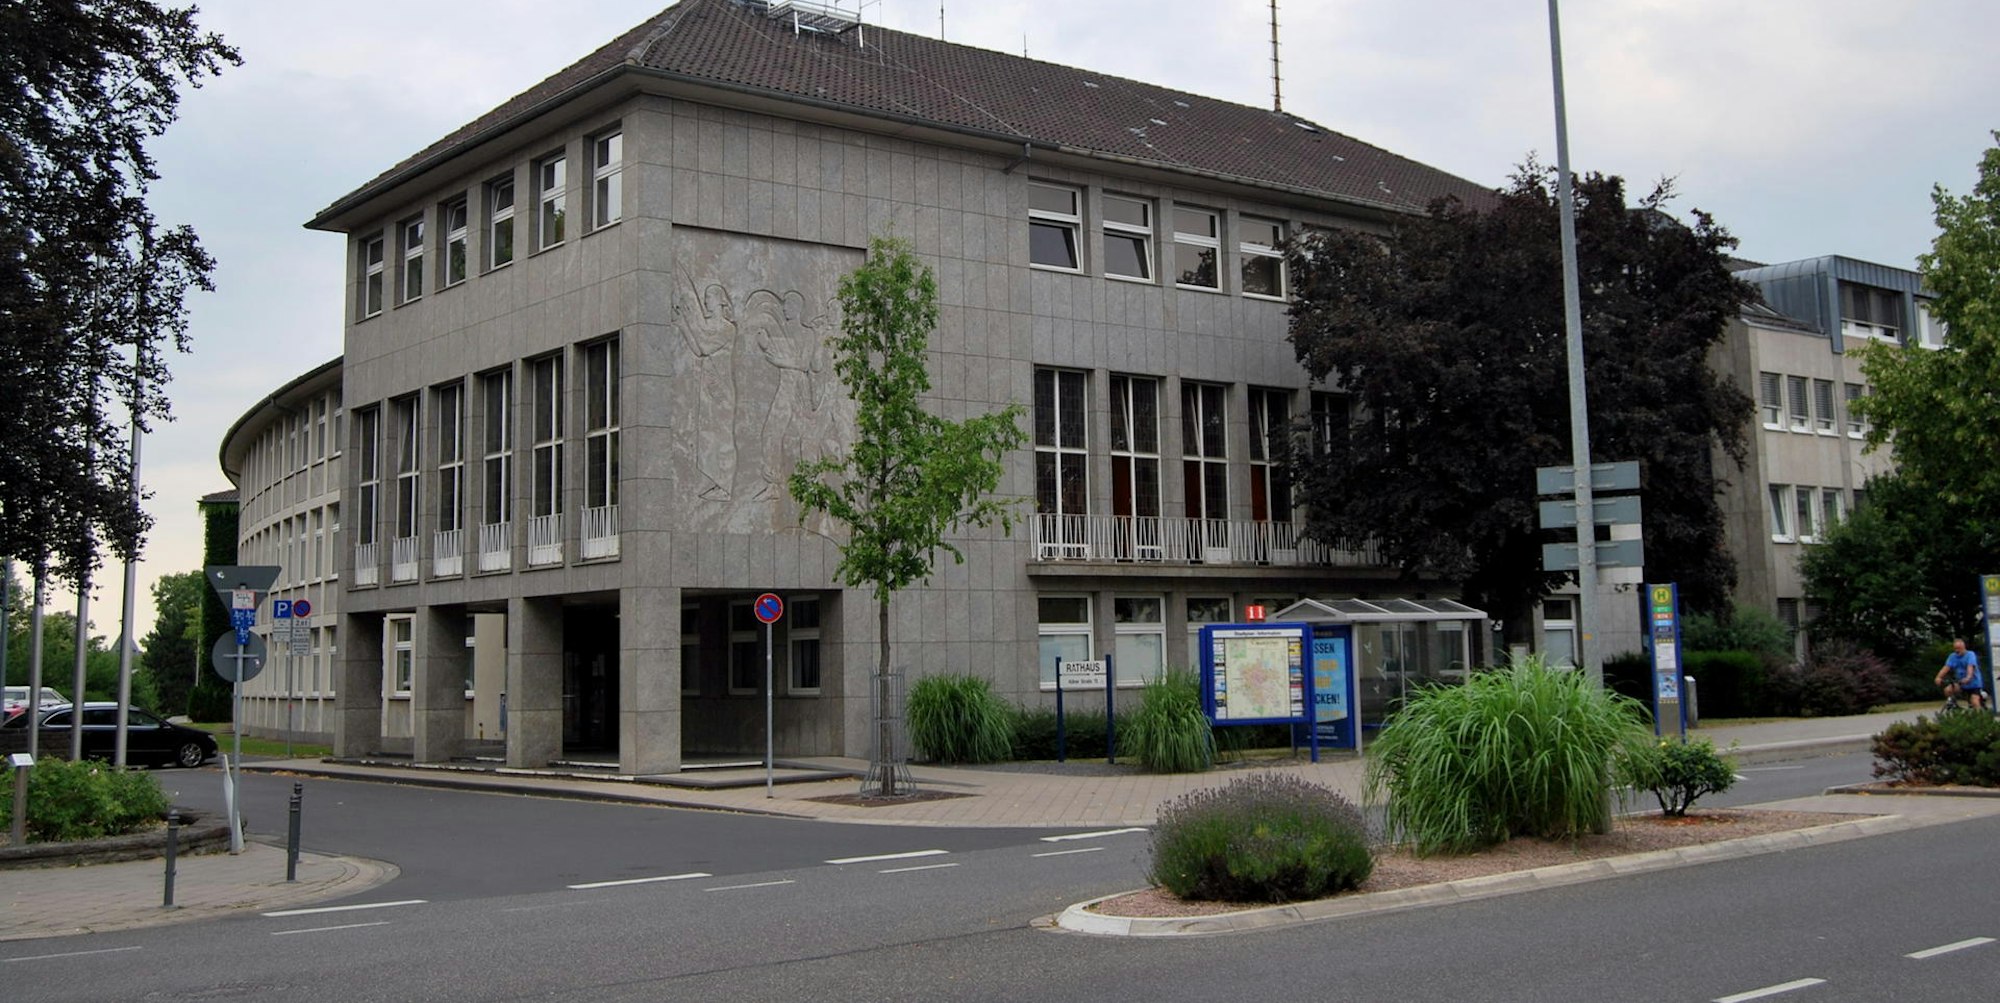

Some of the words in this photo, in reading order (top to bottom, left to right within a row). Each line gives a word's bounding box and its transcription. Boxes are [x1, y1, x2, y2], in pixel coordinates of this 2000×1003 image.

[1657, 591, 1666, 600] H
[277, 602, 288, 616] P
[1248, 606, 1263, 619] 11
[1314, 643, 1335, 654] SSEN
[1066, 662, 1101, 672] RATHAUS
[1315, 693, 1340, 704] CKEN!
